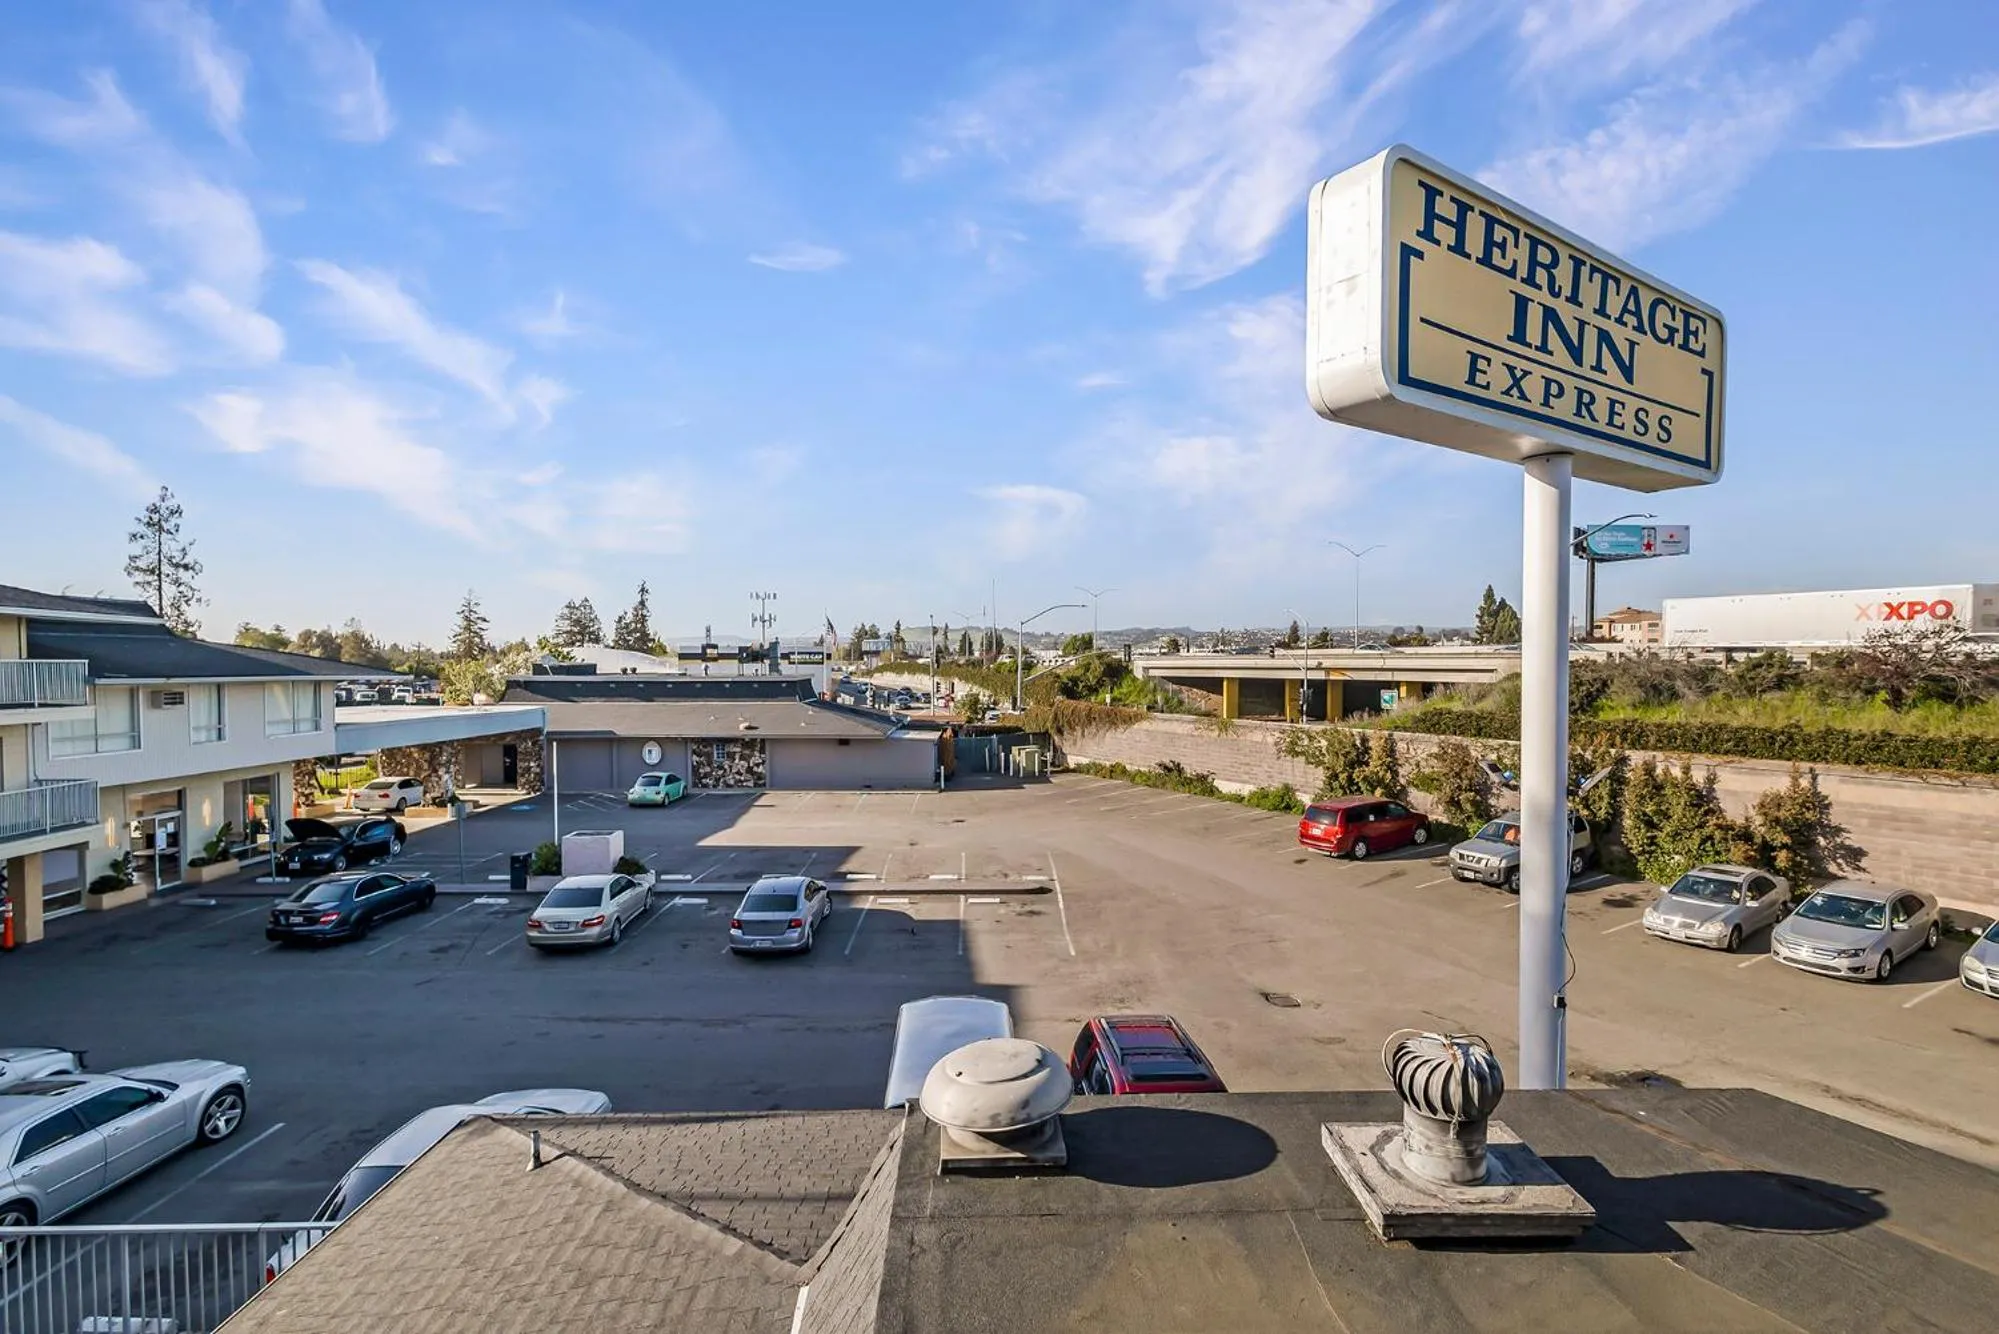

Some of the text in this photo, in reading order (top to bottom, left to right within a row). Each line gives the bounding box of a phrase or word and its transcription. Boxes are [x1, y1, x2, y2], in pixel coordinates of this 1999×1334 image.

[1415, 179, 1708, 359] HERITAGE
[1506, 289, 1641, 386] INN
[1464, 350, 1673, 444] EXPRESS
[1882, 599, 1954, 621] XPO
